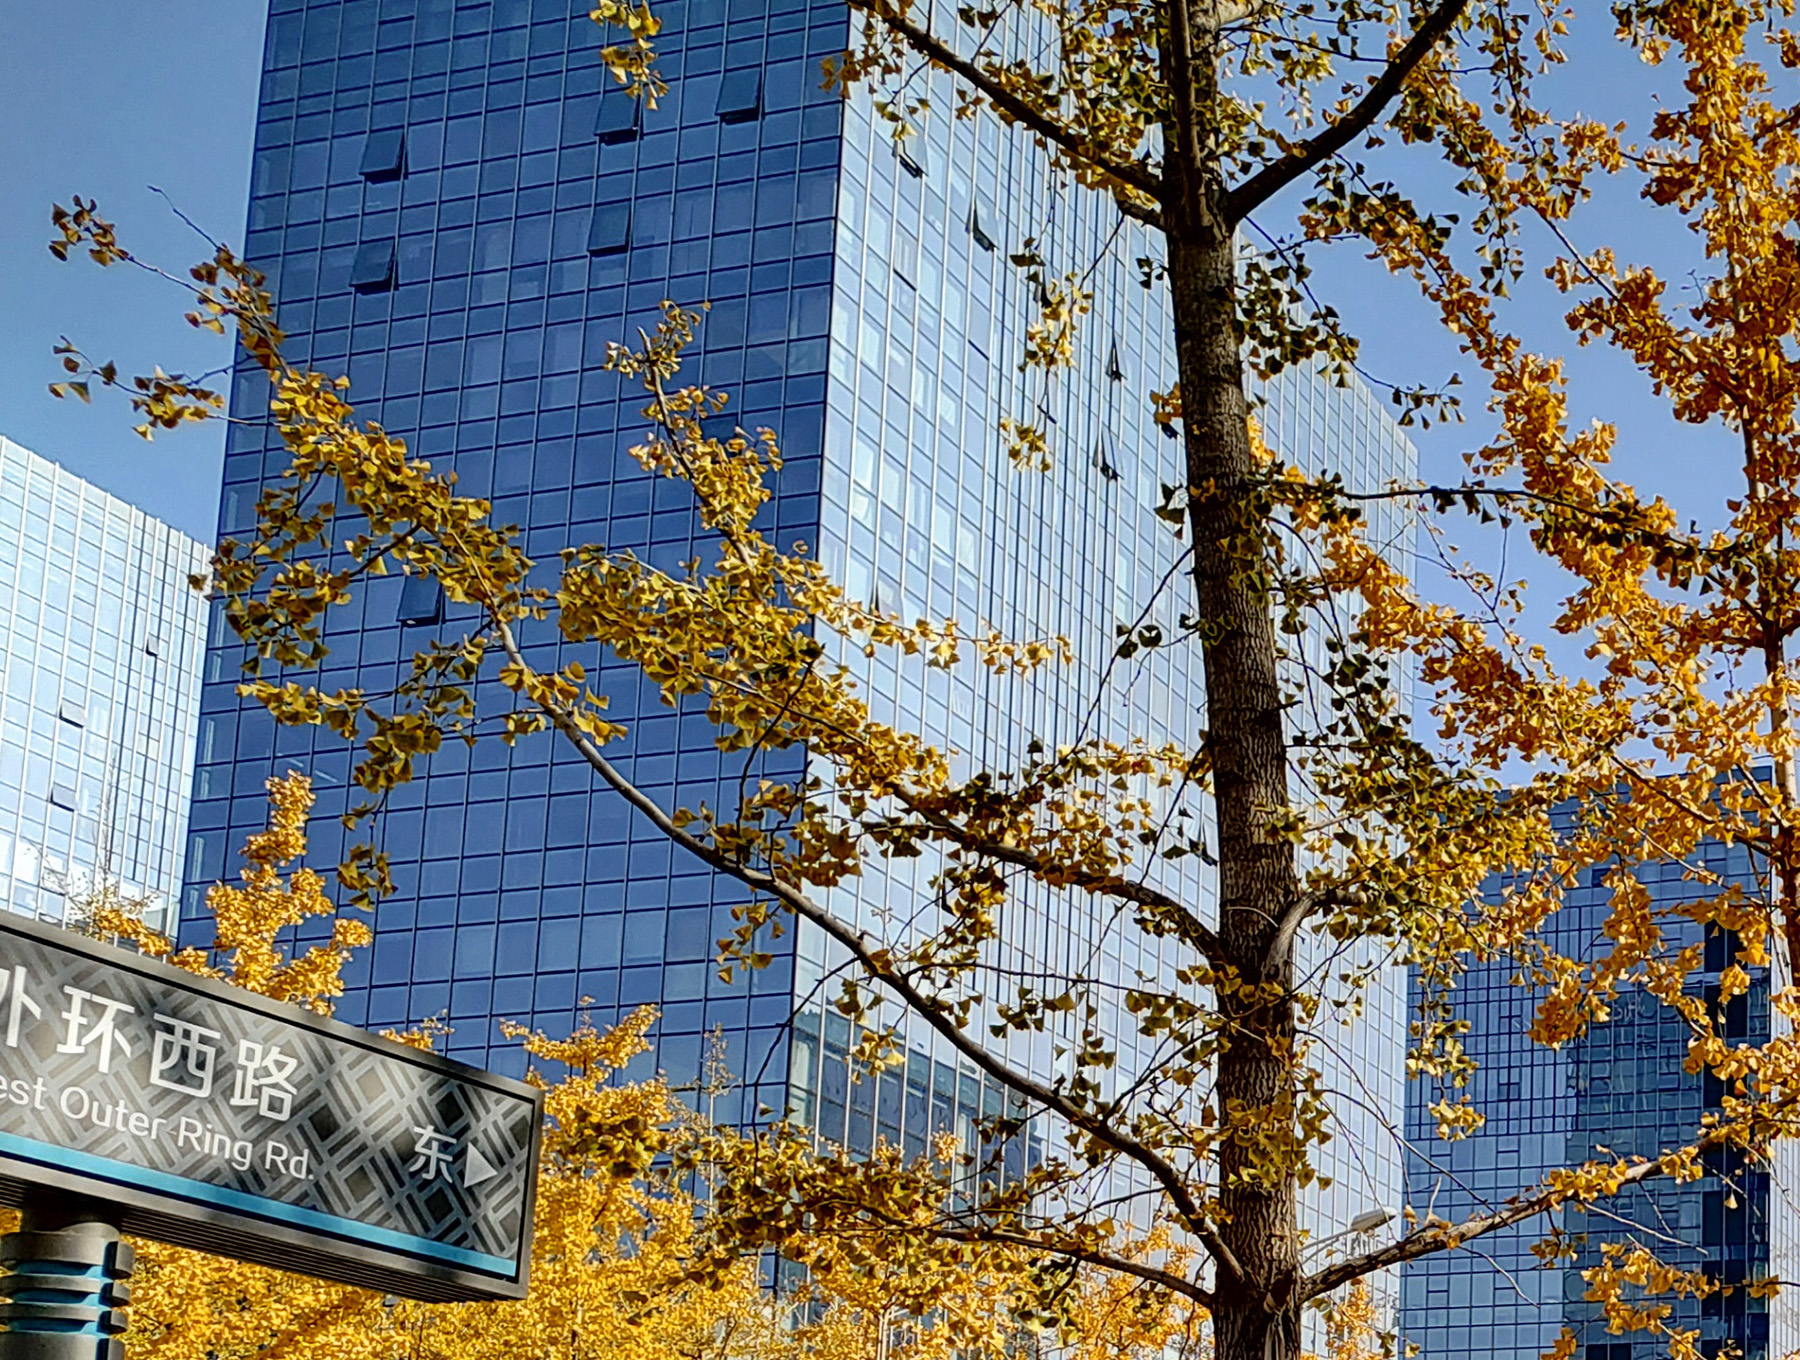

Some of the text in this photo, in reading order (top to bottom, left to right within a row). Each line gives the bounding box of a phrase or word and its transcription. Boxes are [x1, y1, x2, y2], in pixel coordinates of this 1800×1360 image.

[60, 1086, 168, 1140] Outer
[178, 1117, 253, 1171] Ring
[265, 1141, 315, 1181] Rd.
[409, 1125, 457, 1184] 东
